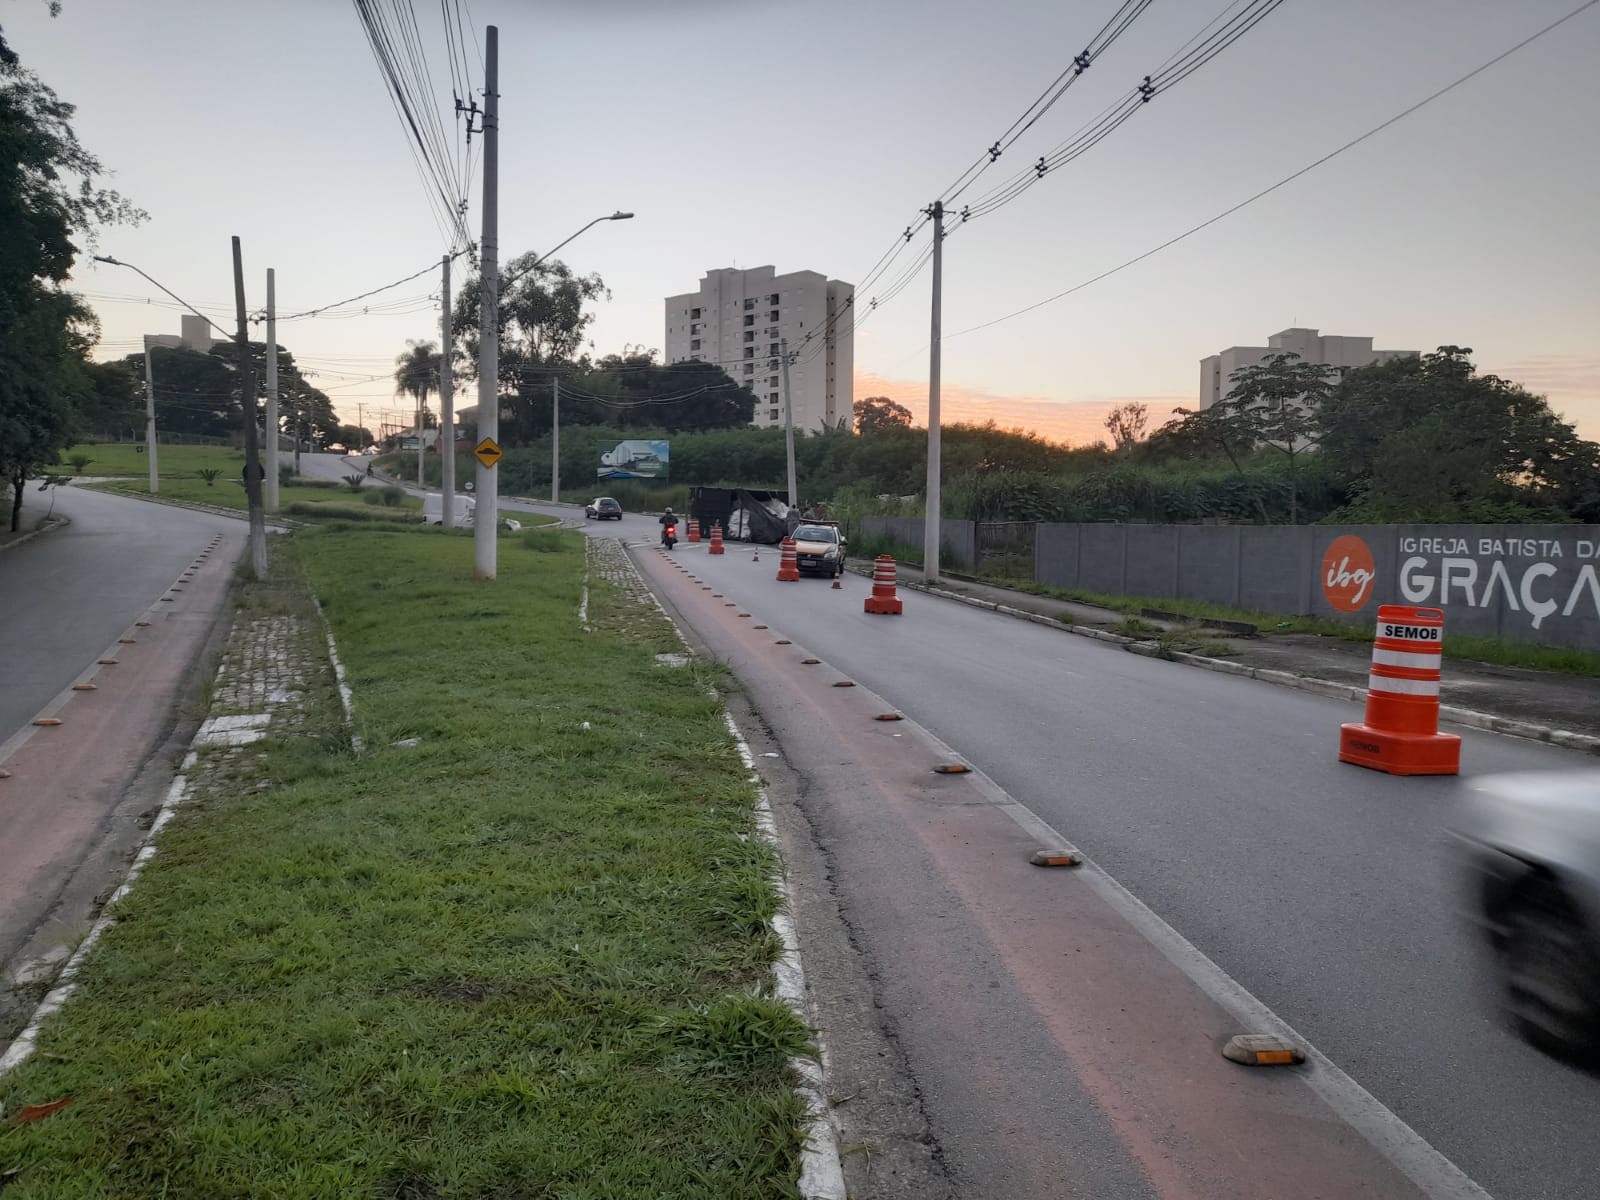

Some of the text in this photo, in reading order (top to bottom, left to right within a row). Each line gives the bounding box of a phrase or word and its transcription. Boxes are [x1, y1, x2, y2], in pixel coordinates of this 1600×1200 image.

[1400, 537, 1469, 555] IGREJA
[1479, 538, 1563, 557] BATISTA
[1327, 556, 1375, 603] ibg
[1400, 557, 1600, 629] GRAÇA
[1385, 625, 1438, 639] SEMOB
